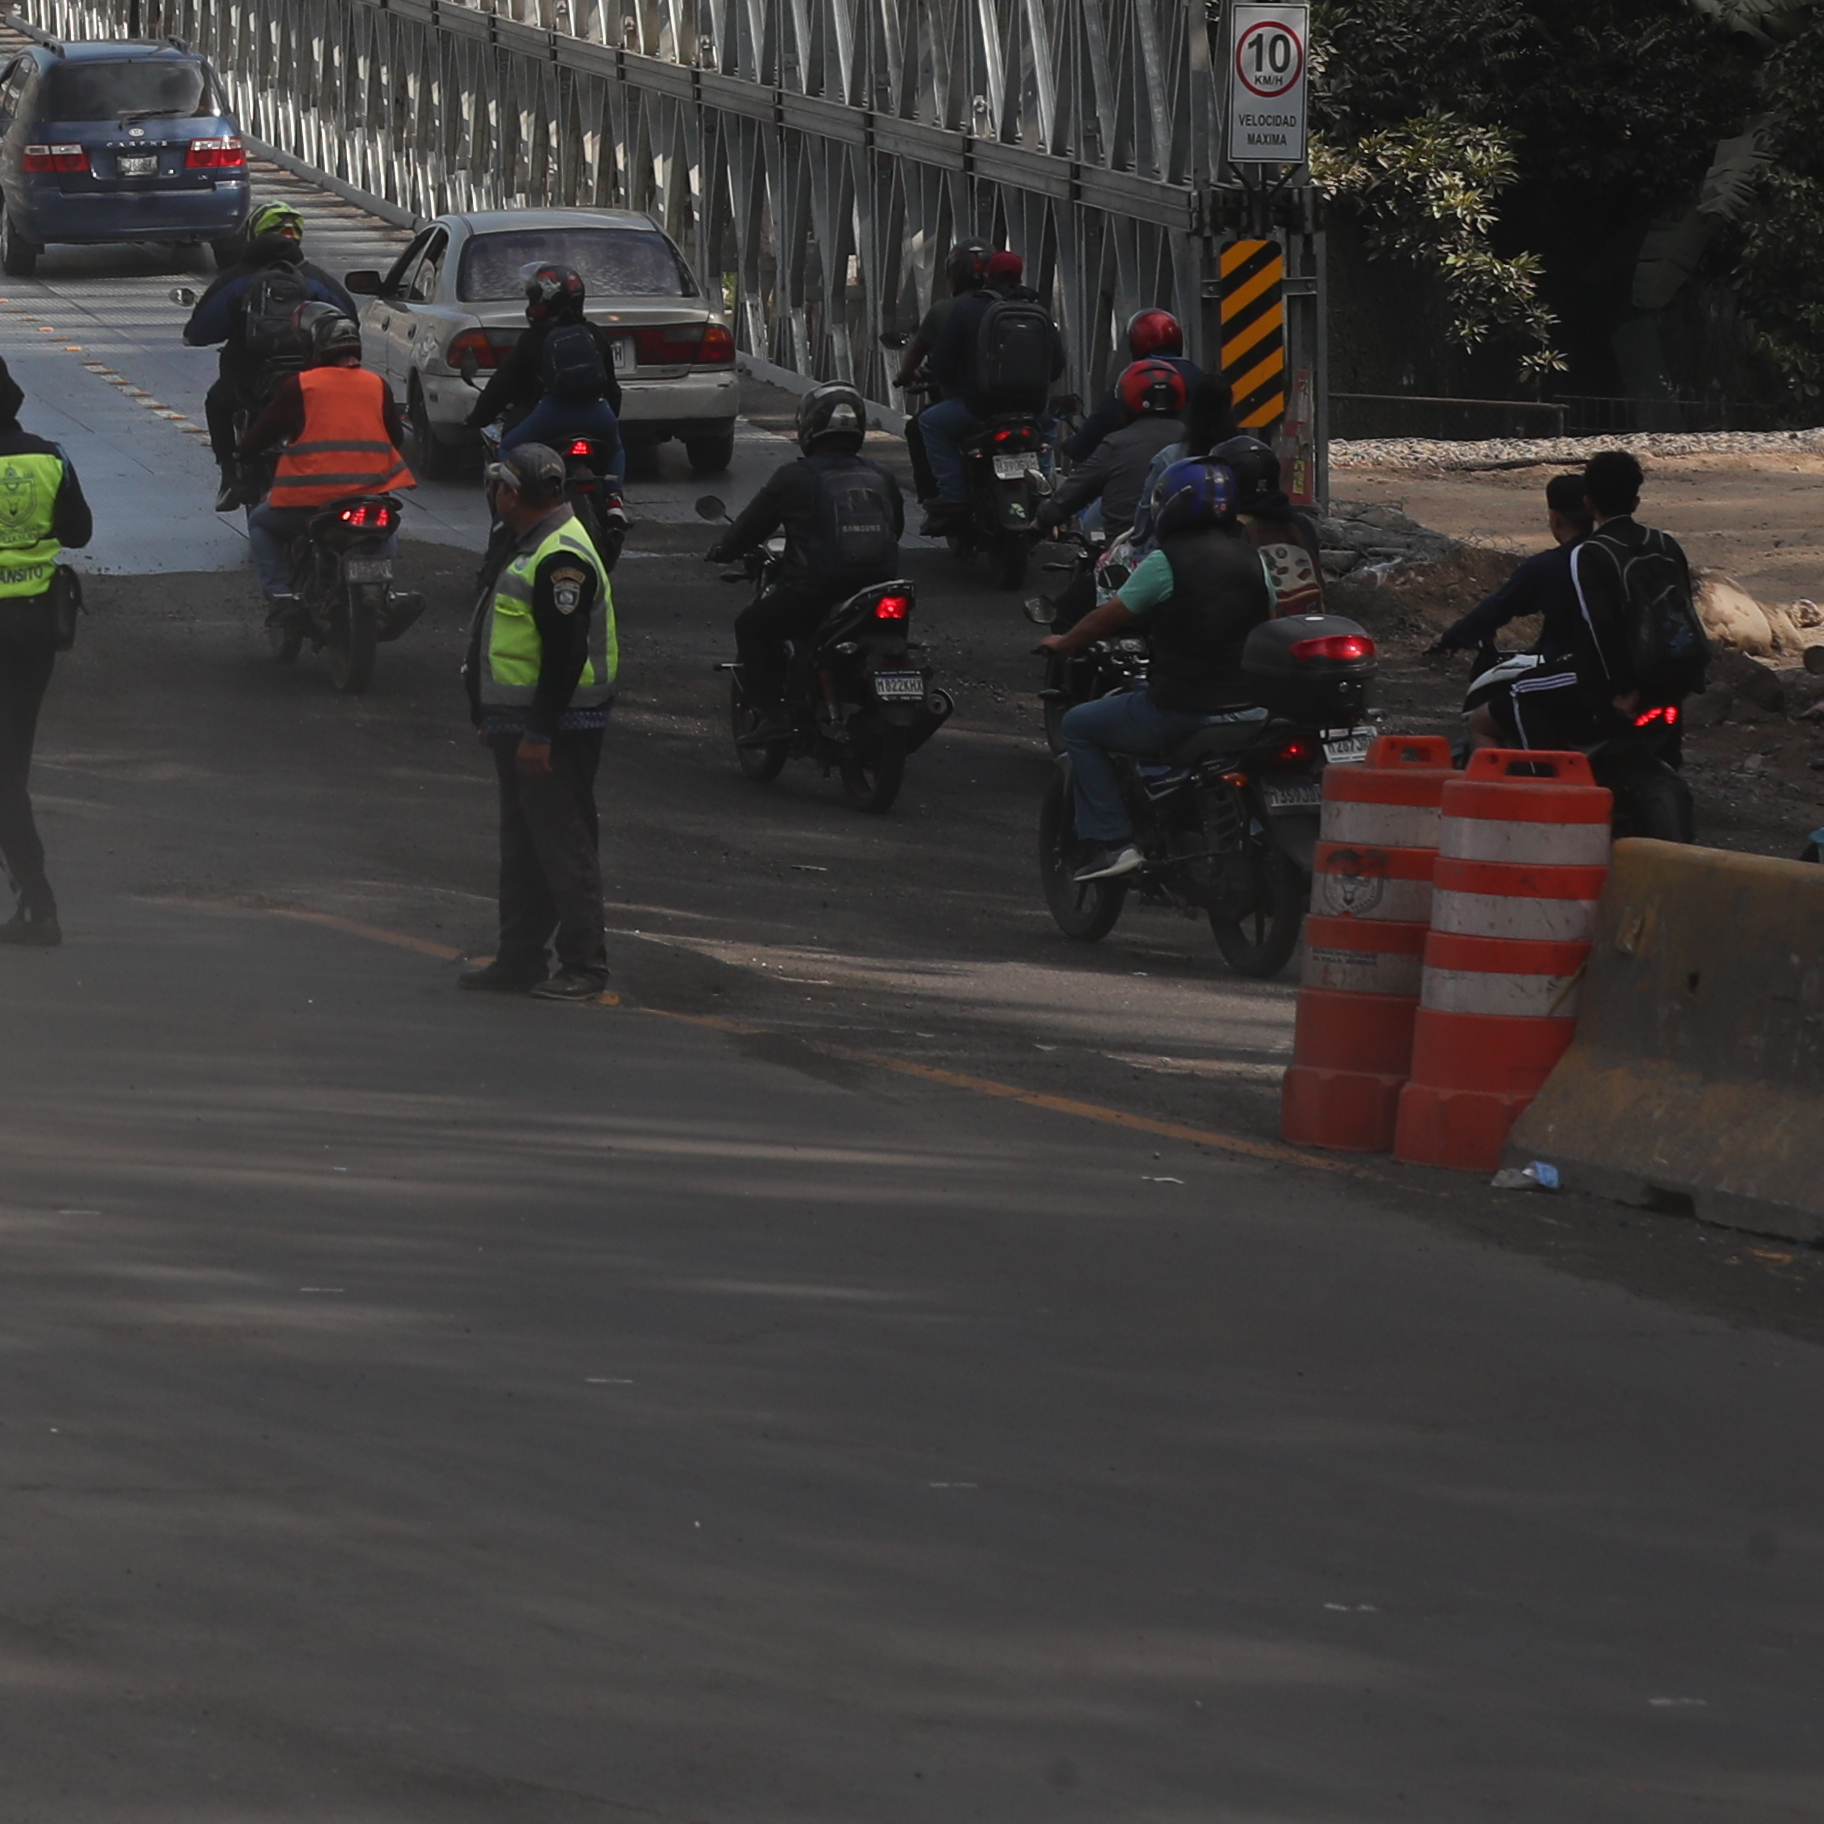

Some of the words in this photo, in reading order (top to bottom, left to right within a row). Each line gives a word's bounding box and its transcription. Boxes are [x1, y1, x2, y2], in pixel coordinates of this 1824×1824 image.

[1247, 33, 1291, 74] 10
[1254, 75, 1284, 86] KM/H
[1238, 113, 1297, 128] VELOCIDAD
[1247, 133, 1288, 146] MAXIMA
